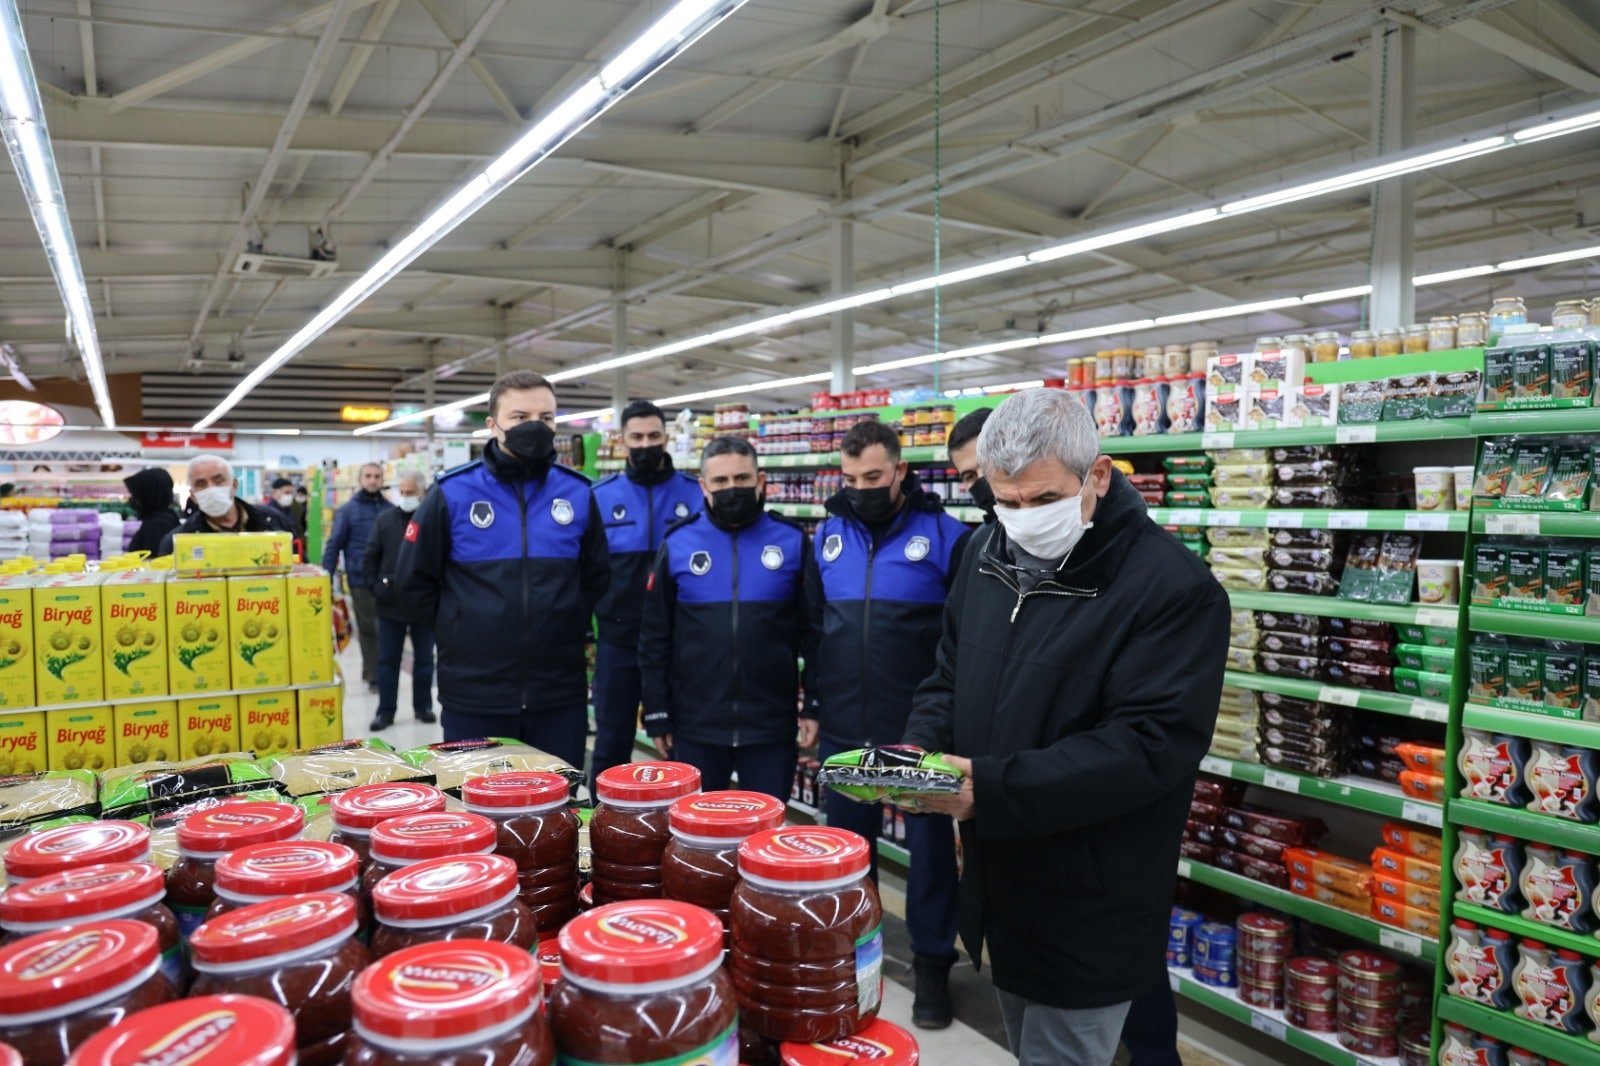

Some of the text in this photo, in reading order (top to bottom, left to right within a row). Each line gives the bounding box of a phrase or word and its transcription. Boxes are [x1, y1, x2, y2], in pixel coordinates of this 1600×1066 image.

[43, 605, 94, 626] Biryağ
[110, 602, 158, 623] Biryağ
[175, 600, 221, 619] Biryağ
[237, 597, 280, 616] Biryağ
[188, 714, 232, 733] Biryağ
[248, 708, 290, 727] Biryağ
[56, 725, 106, 747] Biryağ
[122, 720, 169, 741] Biryağ
